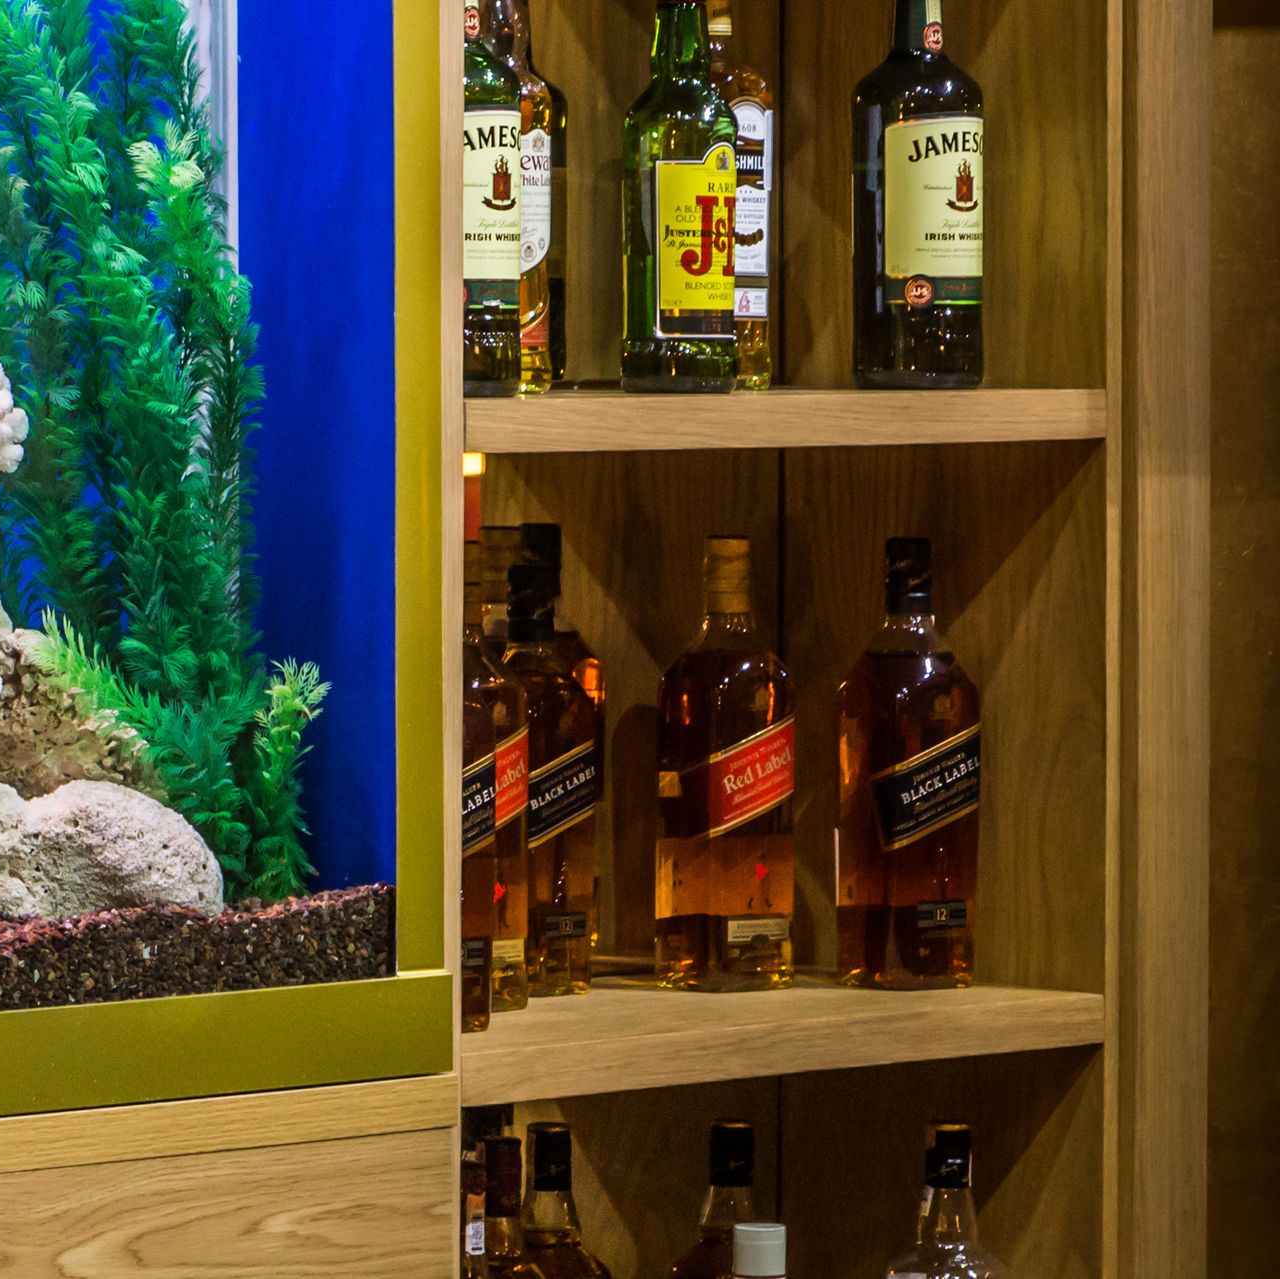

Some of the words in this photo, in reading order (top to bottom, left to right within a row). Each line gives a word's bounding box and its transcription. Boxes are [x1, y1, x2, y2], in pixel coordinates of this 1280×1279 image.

[675, 205, 681, 213] A
[675, 214, 696, 223] OLD
[925, 233, 956, 241] IRISH
[685, 282, 721, 290] BLENDED
[723, 766, 755, 794] Red
[755, 745, 791, 780] Label
[901, 776, 943, 805] BLACK
[944, 756, 981, 784] LABEL
[530, 783, 564, 811] BLACK
[936, 908, 947, 921] 12
